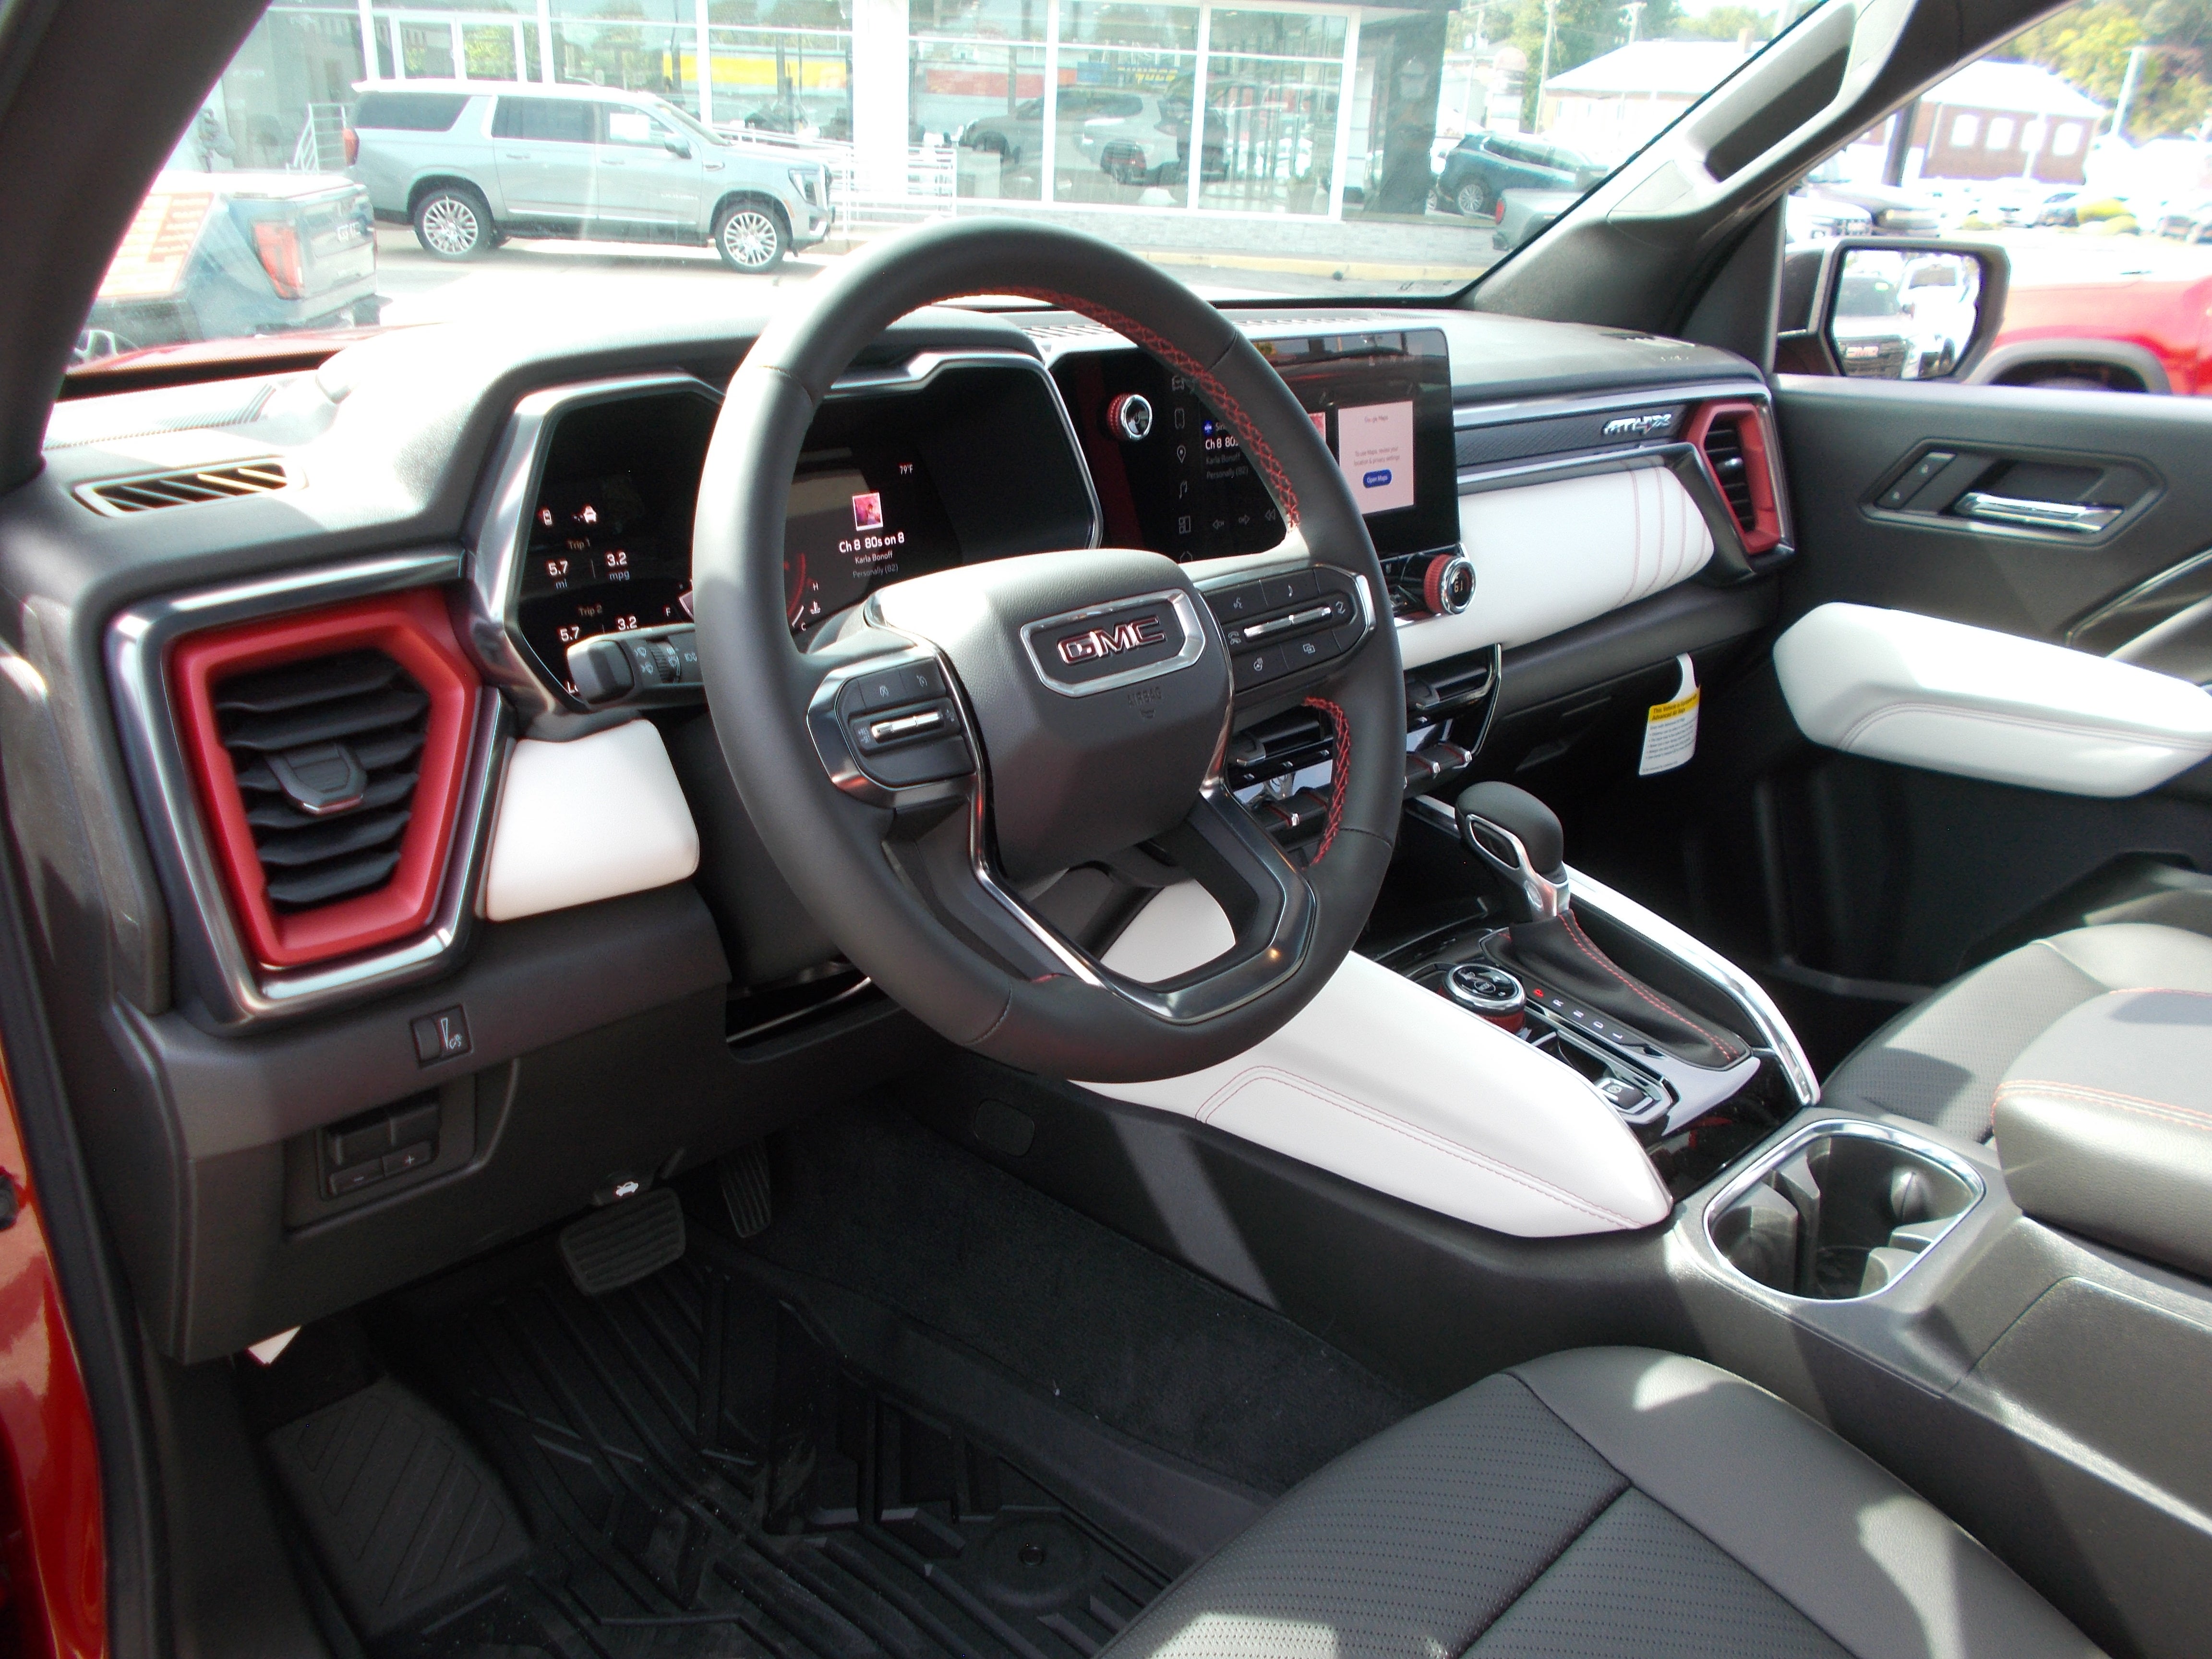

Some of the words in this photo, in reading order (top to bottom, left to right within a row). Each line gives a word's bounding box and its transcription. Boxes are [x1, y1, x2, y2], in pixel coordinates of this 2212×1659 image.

[1205, 438, 1215, 450] Ch
[1217, 437, 1222, 449] 8
[568, 539, 585, 551] Trip
[839, 541, 852, 553] Ch
[854, 539, 861, 551] 8
[865, 536, 883, 549] 80s
[884, 535, 897, 546] on
[898, 531, 905, 543] 8
[606, 552, 628, 566] 3.2
[854, 553, 872, 565] Karla
[872, 550, 893, 562] Bonoff
[548, 560, 569, 576] 5.7
[853, 566, 884, 578] Personally
[609, 570, 630, 581] mpg
[813, 582, 819, 591] H
[1454, 579, 1463, 593] 61
[578, 607, 594, 617] Trip
[665, 607, 671, 617] F
[617, 615, 637, 631] 3.2
[801, 623, 806, 631] C
[560, 625, 580, 642] 5.7
[1057, 615, 1166, 665] GMC
[1127, 686, 1162, 707] AIRBAG
[1553, 999, 1564, 1007] R
